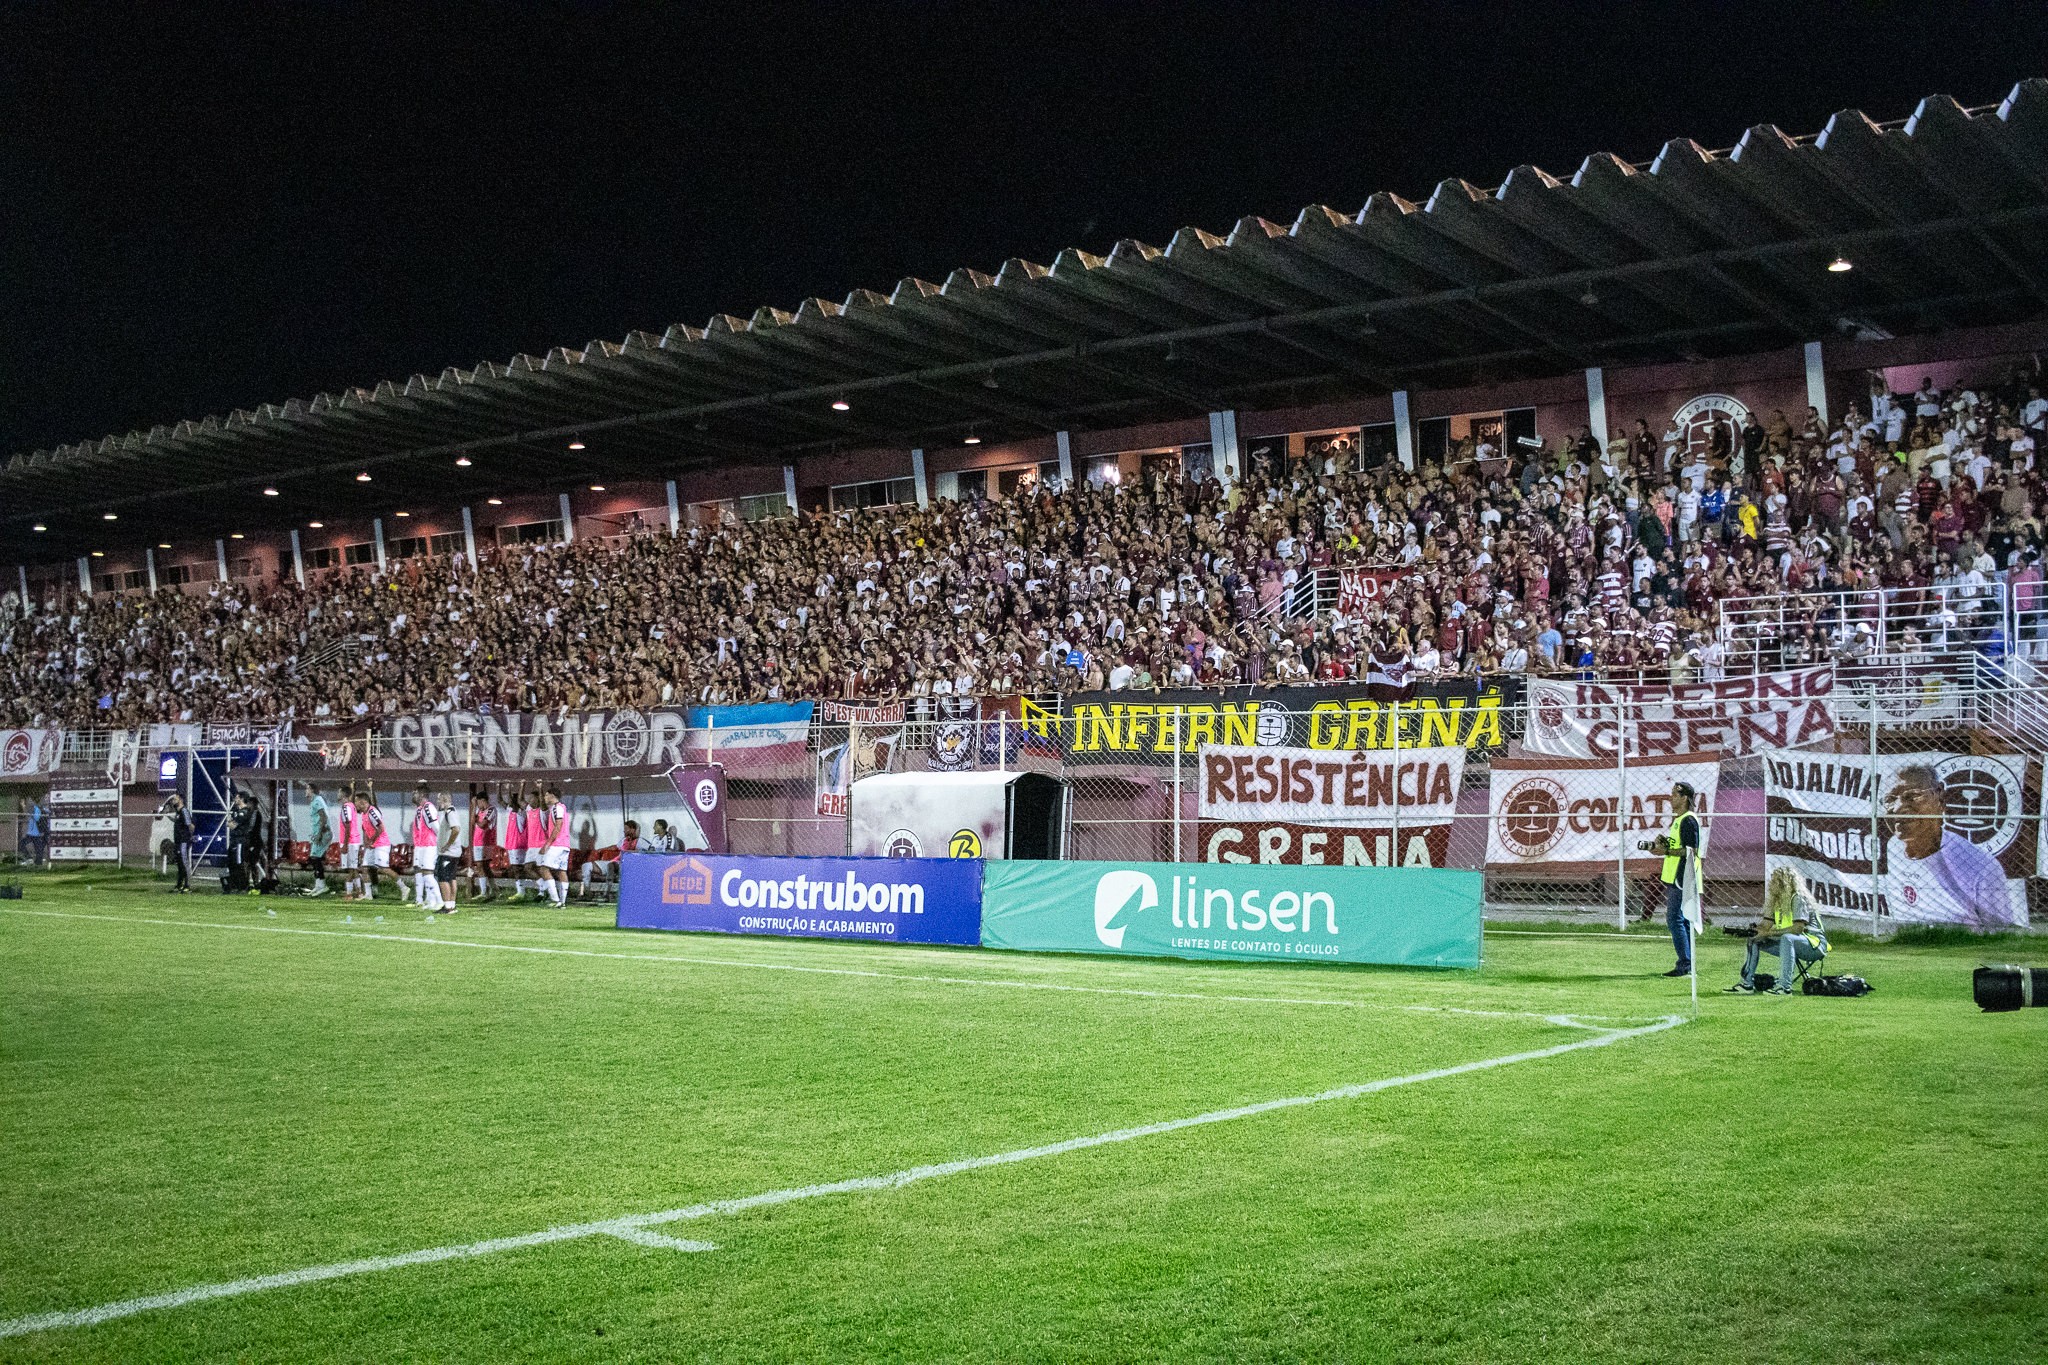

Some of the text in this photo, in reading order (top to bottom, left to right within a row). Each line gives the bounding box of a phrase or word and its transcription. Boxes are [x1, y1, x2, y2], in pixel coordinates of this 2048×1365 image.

[1575, 668, 1834, 720] INFERNO
[212, 725, 246, 741] ESTAÇÃO
[1309, 685, 1503, 752] GRENÁ
[1205, 751, 1454, 807] RESISTÊNCIA
[1207, 826, 1433, 868] GRENÁ
[670, 876, 703, 892] REDE
[720, 868, 924, 914] Construbom
[1171, 875, 1339, 935] linsen
[738, 915, 895, 935] CONSTRUÇÃO E ACABAMENTO
[1171, 938, 1339, 955] LENTES DE CONTATO E ÓCULOS
